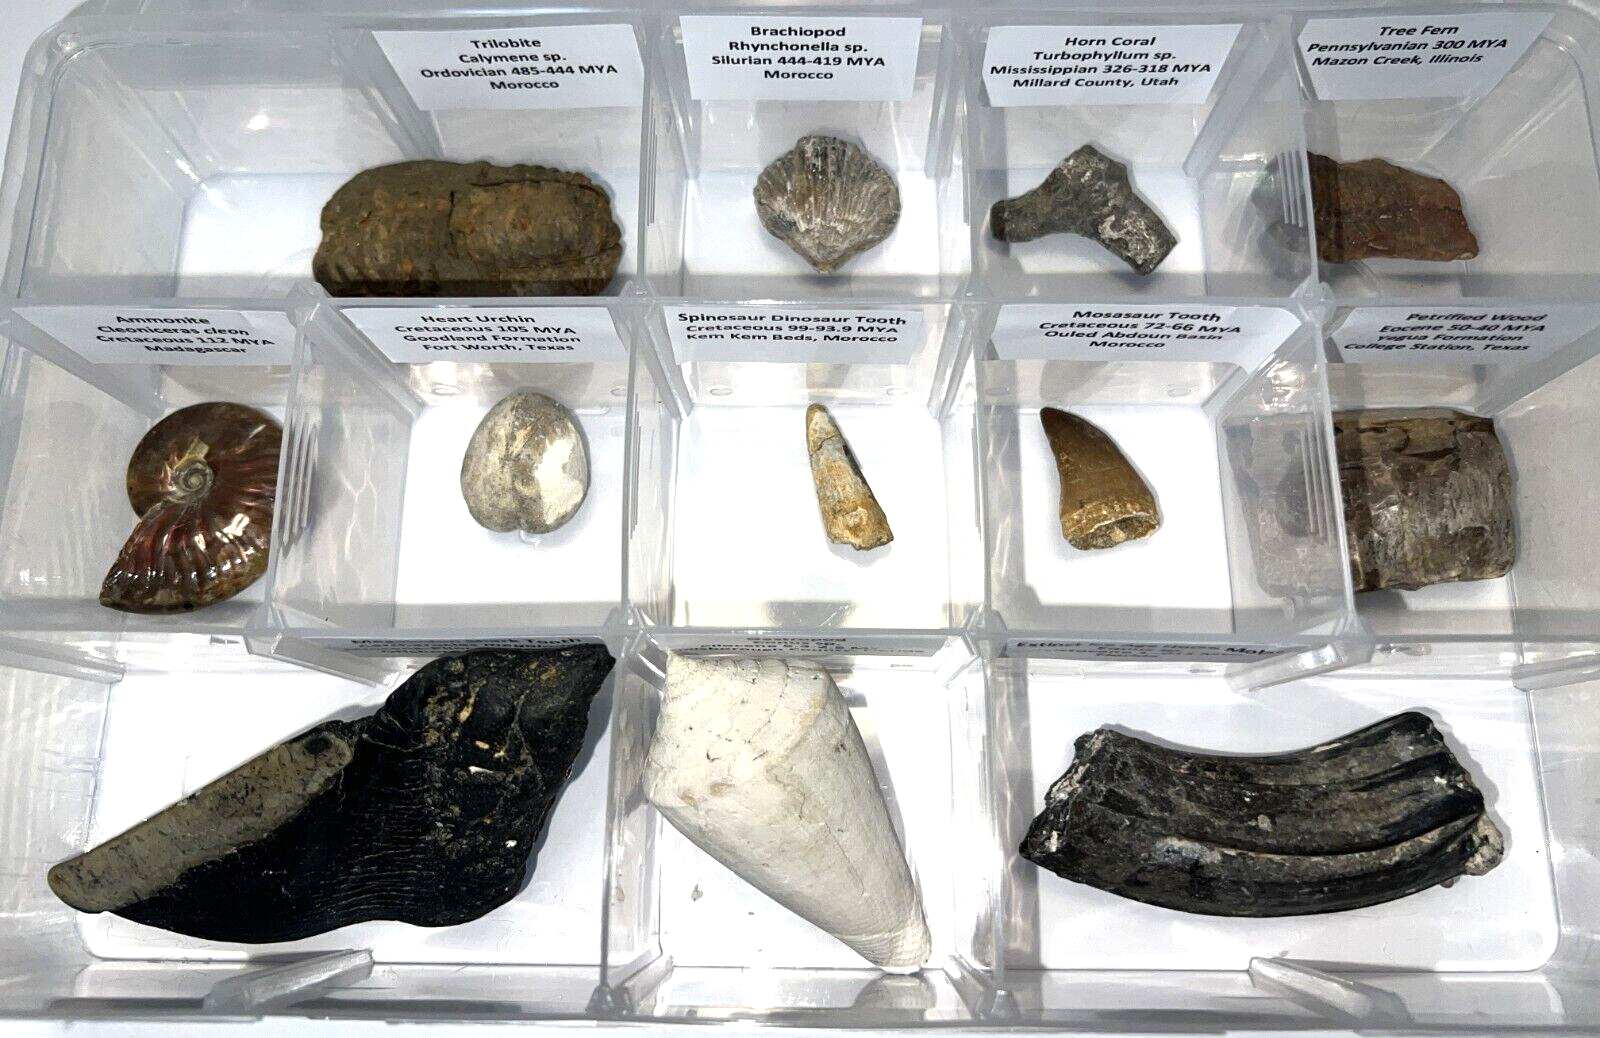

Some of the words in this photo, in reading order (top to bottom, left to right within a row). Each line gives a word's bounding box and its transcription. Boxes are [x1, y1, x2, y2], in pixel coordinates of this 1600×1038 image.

[751, 27, 846, 38] Brachiopod
[1379, 27, 1417, 36] Tree
[1420, 26, 1459, 35] Fern
[470, 39, 541, 49] Trilobite
[1065, 37, 1106, 46] Horn
[1111, 37, 1156, 46] Coral
[1307, 42, 1429, 53] Pennsylvanian
[1432, 40, 1464, 49] 300
[1467, 39, 1508, 48] MYA
[729, 42, 839, 52] Rhynchonella
[844, 44, 868, 53] sp.
[459, 54, 539, 64] Calymene
[543, 53, 567, 61] sp.
[711, 56, 773, 65] Silurian
[777, 56, 842, 66] 444-419
[846, 57, 886, 66] MYA
[1033, 51, 1148, 61] Turbophyllum
[1152, 52, 1176, 60] sp.
[1311, 57, 1368, 66] Mazon
[1373, 55, 1423, 65] Creek,
[1428, 54, 1484, 63] Illinois
[420, 68, 507, 78] Ordovician
[511, 66, 575, 75] 485-444
[578, 64, 618, 74] MYA
[764, 70, 834, 79] Morocco
[989, 66, 1098, 76] Mississippian
[1102, 65, 1168, 73] 326-318
[1171, 64, 1211, 73] MYA
[490, 81, 560, 90] Morocco
[1012, 79, 1070, 88] Millard
[1074, 78, 1136, 88] County,
[1140, 77, 1179, 86] Utah
[116, 316, 210, 324] Ammonite
[678, 313, 766, 323] Spinosaur
[771, 314, 851, 323] Dinosaur
[854, 316, 906, 325] Tooth
[1072, 311, 1163, 319] Mosasaur
[1168, 312, 1221, 322] Tooth
[1405, 313, 1487, 321] Petrified
[1491, 313, 1548, 321] Wood
[97, 326, 200, 334] Cleoniceras
[203, 327, 250, 336] cleon
[496, 325, 529, 333] 105
[532, 326, 577, 334] MYA
[1039, 322, 1138, 330] Cretaceous
[1143, 322, 1193, 331] 72-66
[1197, 325, 1241, 334] MYA
[1378, 325, 1444, 333] Eocene
[1446, 324, 1500, 332] 50-40
[1501, 324, 1545, 332] MYA
[491, 335, 581, 343] Formation
[730, 333, 768, 341] Kem
[771, 334, 818, 343] Beds,
[1044, 330, 1098, 338] Ouled
[1101, 331, 1171, 340] Abdoun
[96, 335, 194, 343] Cretaceous
[231, 337, 275, 346] MYA
[144, 345, 247, 353] Madagascar
[1409, 343, 1474, 351] Station,
